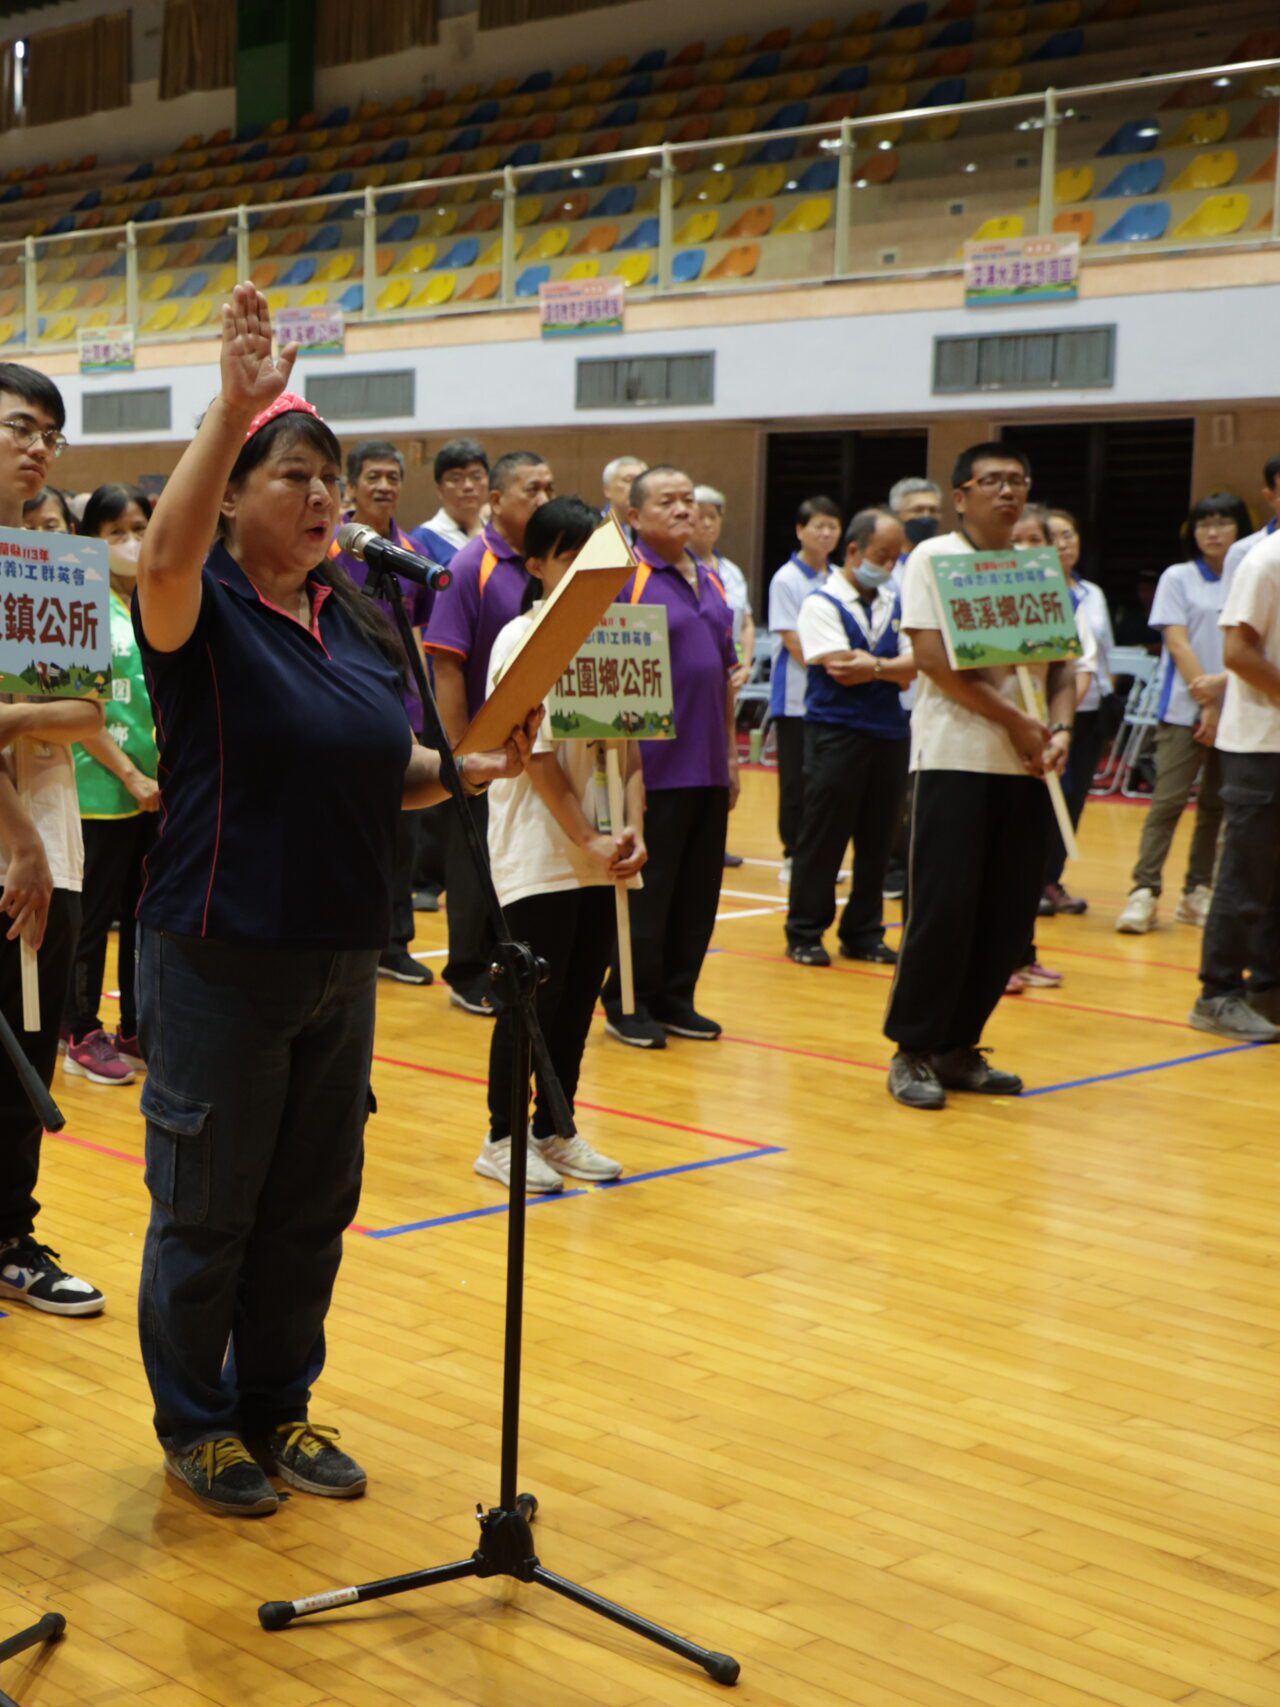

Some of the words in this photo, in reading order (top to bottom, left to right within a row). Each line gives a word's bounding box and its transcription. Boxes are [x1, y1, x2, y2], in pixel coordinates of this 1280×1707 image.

[949, 591, 1065, 632] 礁溪鄉公所
